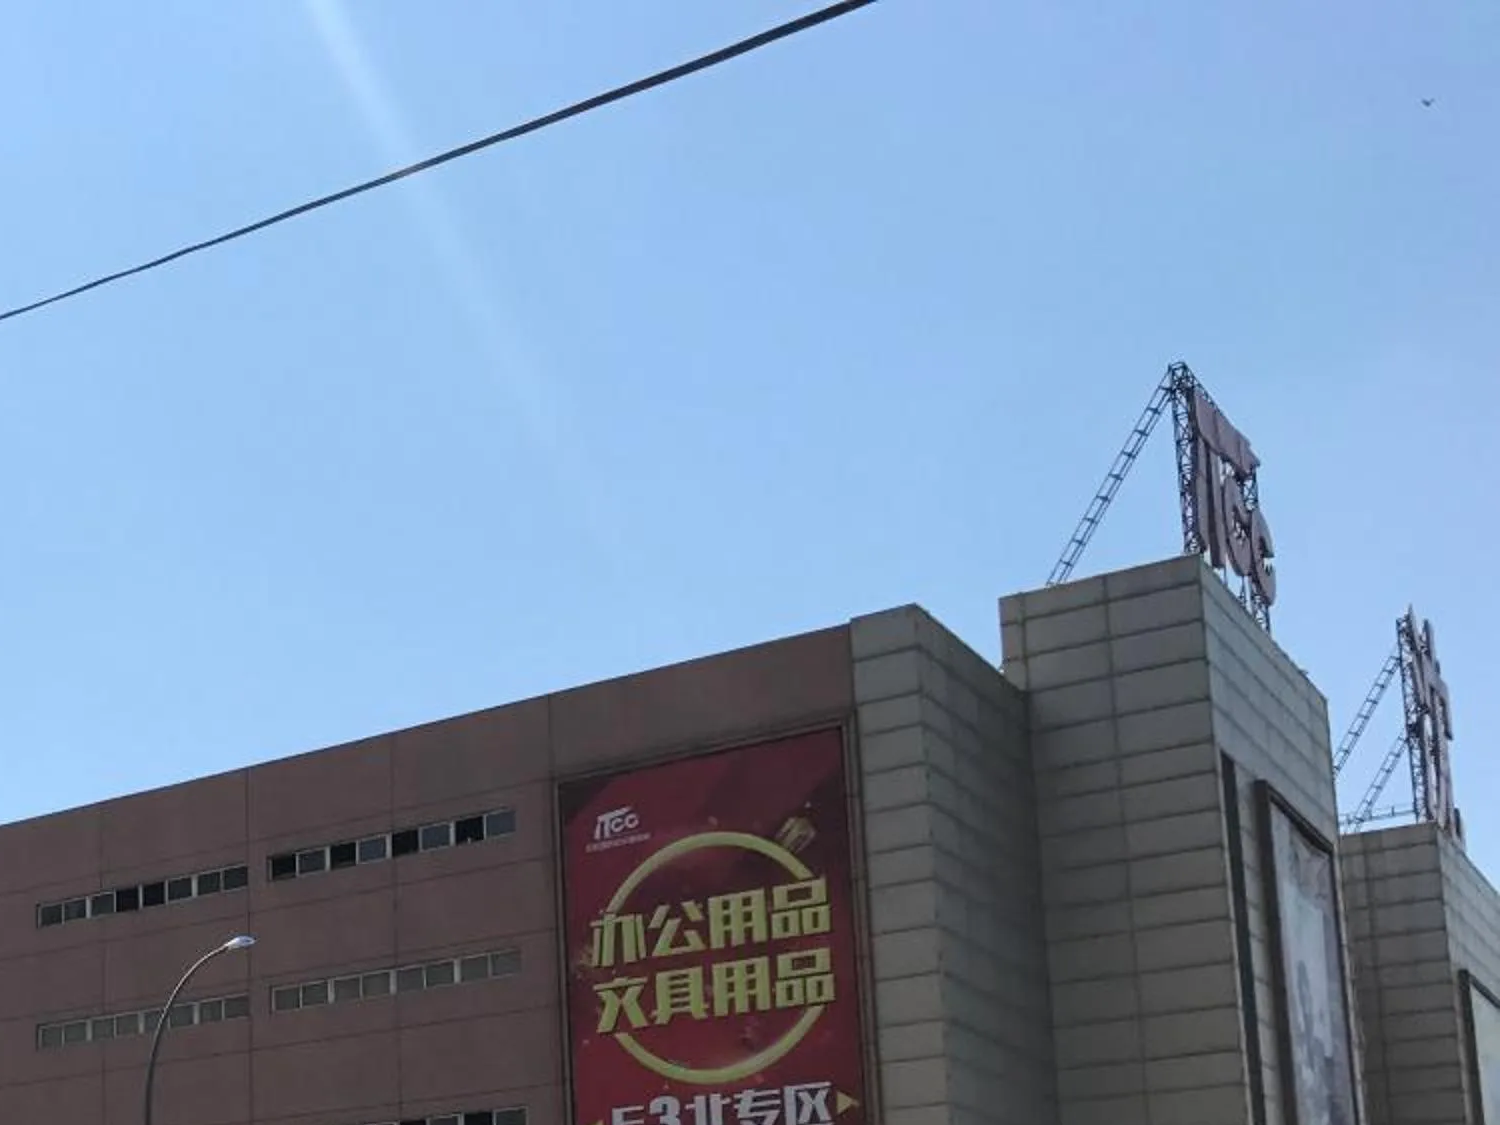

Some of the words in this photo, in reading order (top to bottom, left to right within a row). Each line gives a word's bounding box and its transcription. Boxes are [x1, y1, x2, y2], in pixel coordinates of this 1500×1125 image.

[588, 876, 832, 968] 办公用品
[594, 946, 837, 1034] 文具用品
